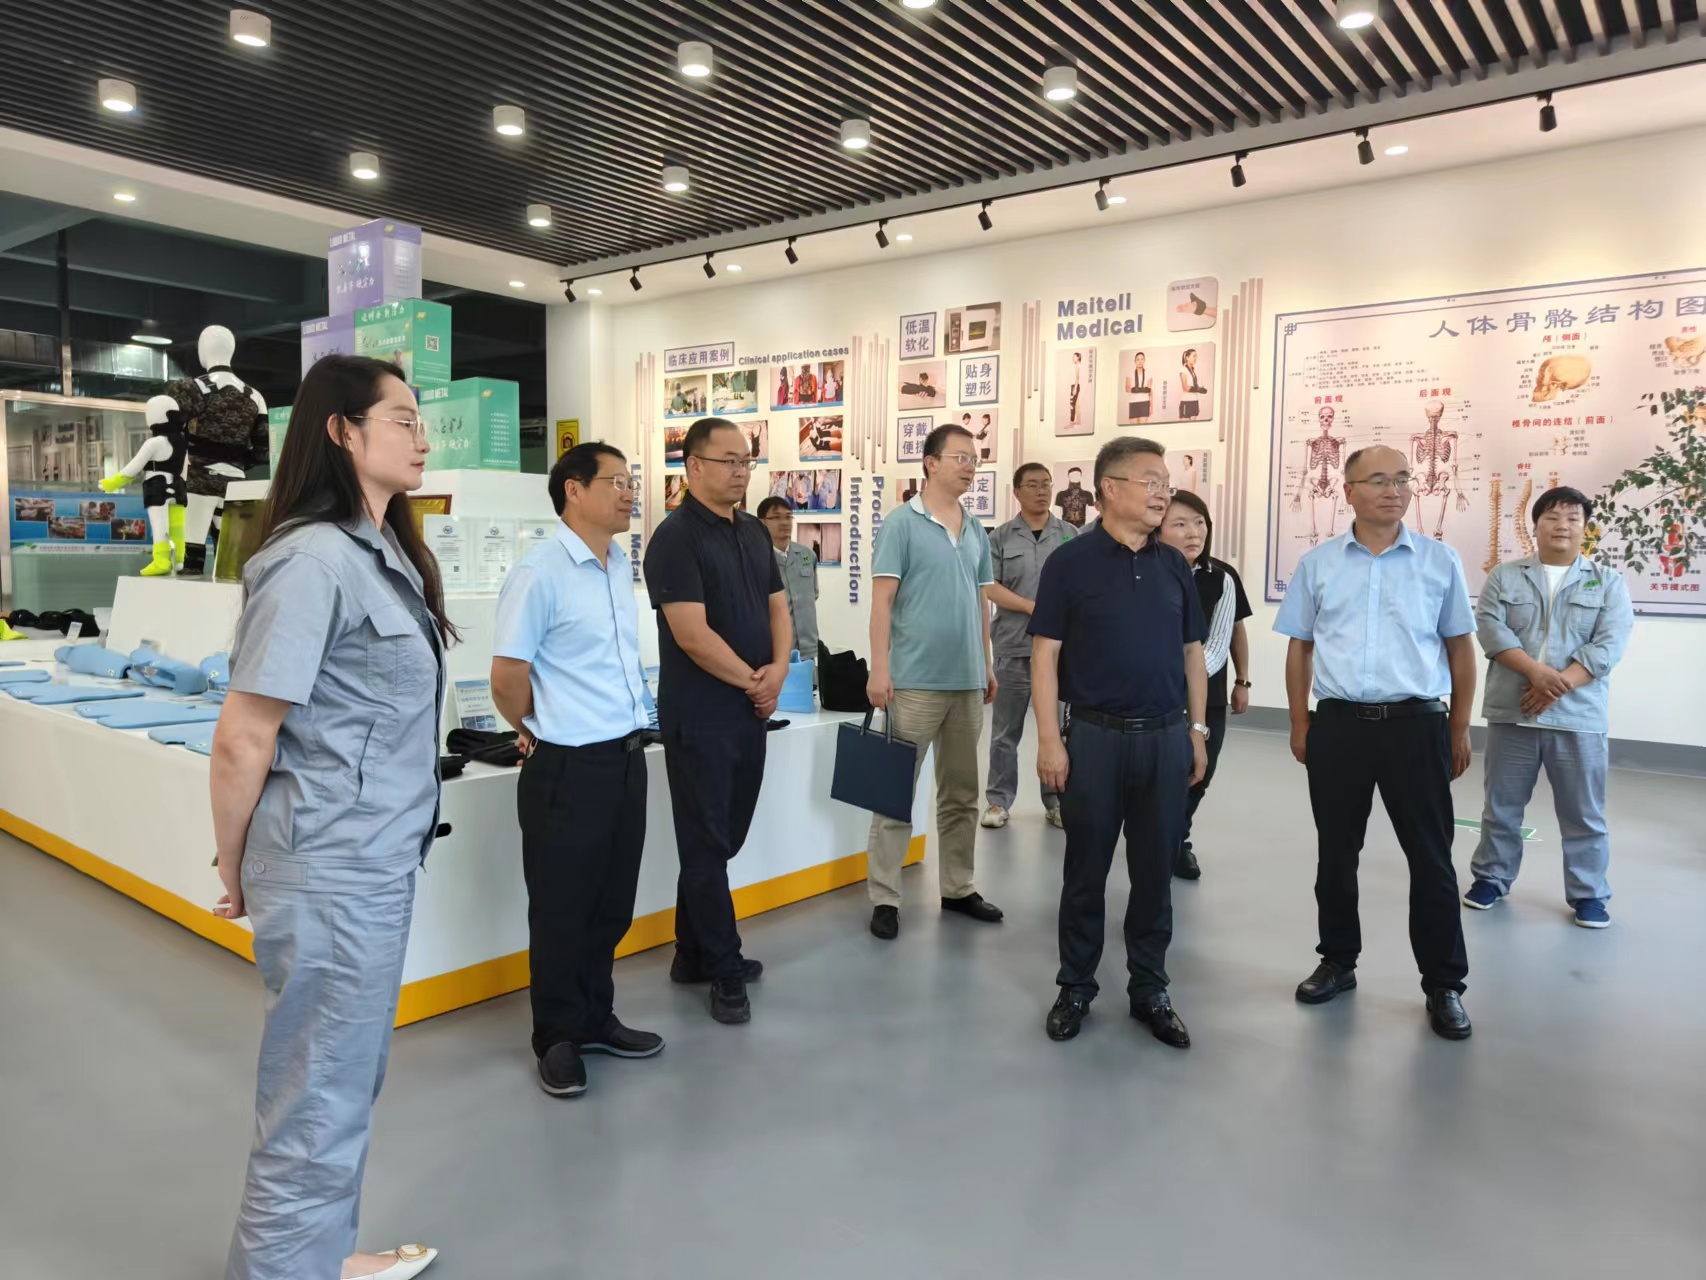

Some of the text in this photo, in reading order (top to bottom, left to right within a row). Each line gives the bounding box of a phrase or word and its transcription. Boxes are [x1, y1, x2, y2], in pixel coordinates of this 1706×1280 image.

[1057, 292, 1132, 317] Maitell
[1429, 295, 1706, 338] 人体骨骼结构图
[905, 318, 930, 335] 低温
[1057, 313, 1143, 341] Medical
[905, 335, 929, 352] 软化
[667, 348, 730, 367] 临床应用案例
[738, 346, 850, 366] Clinical application cases
[965, 362, 992, 379] 贴身
[964, 380, 992, 397] 塑形
[903, 422, 928, 438] 穿戴
[962, 495, 989, 511] 牢靠
[849, 477, 863, 603] Introduction
